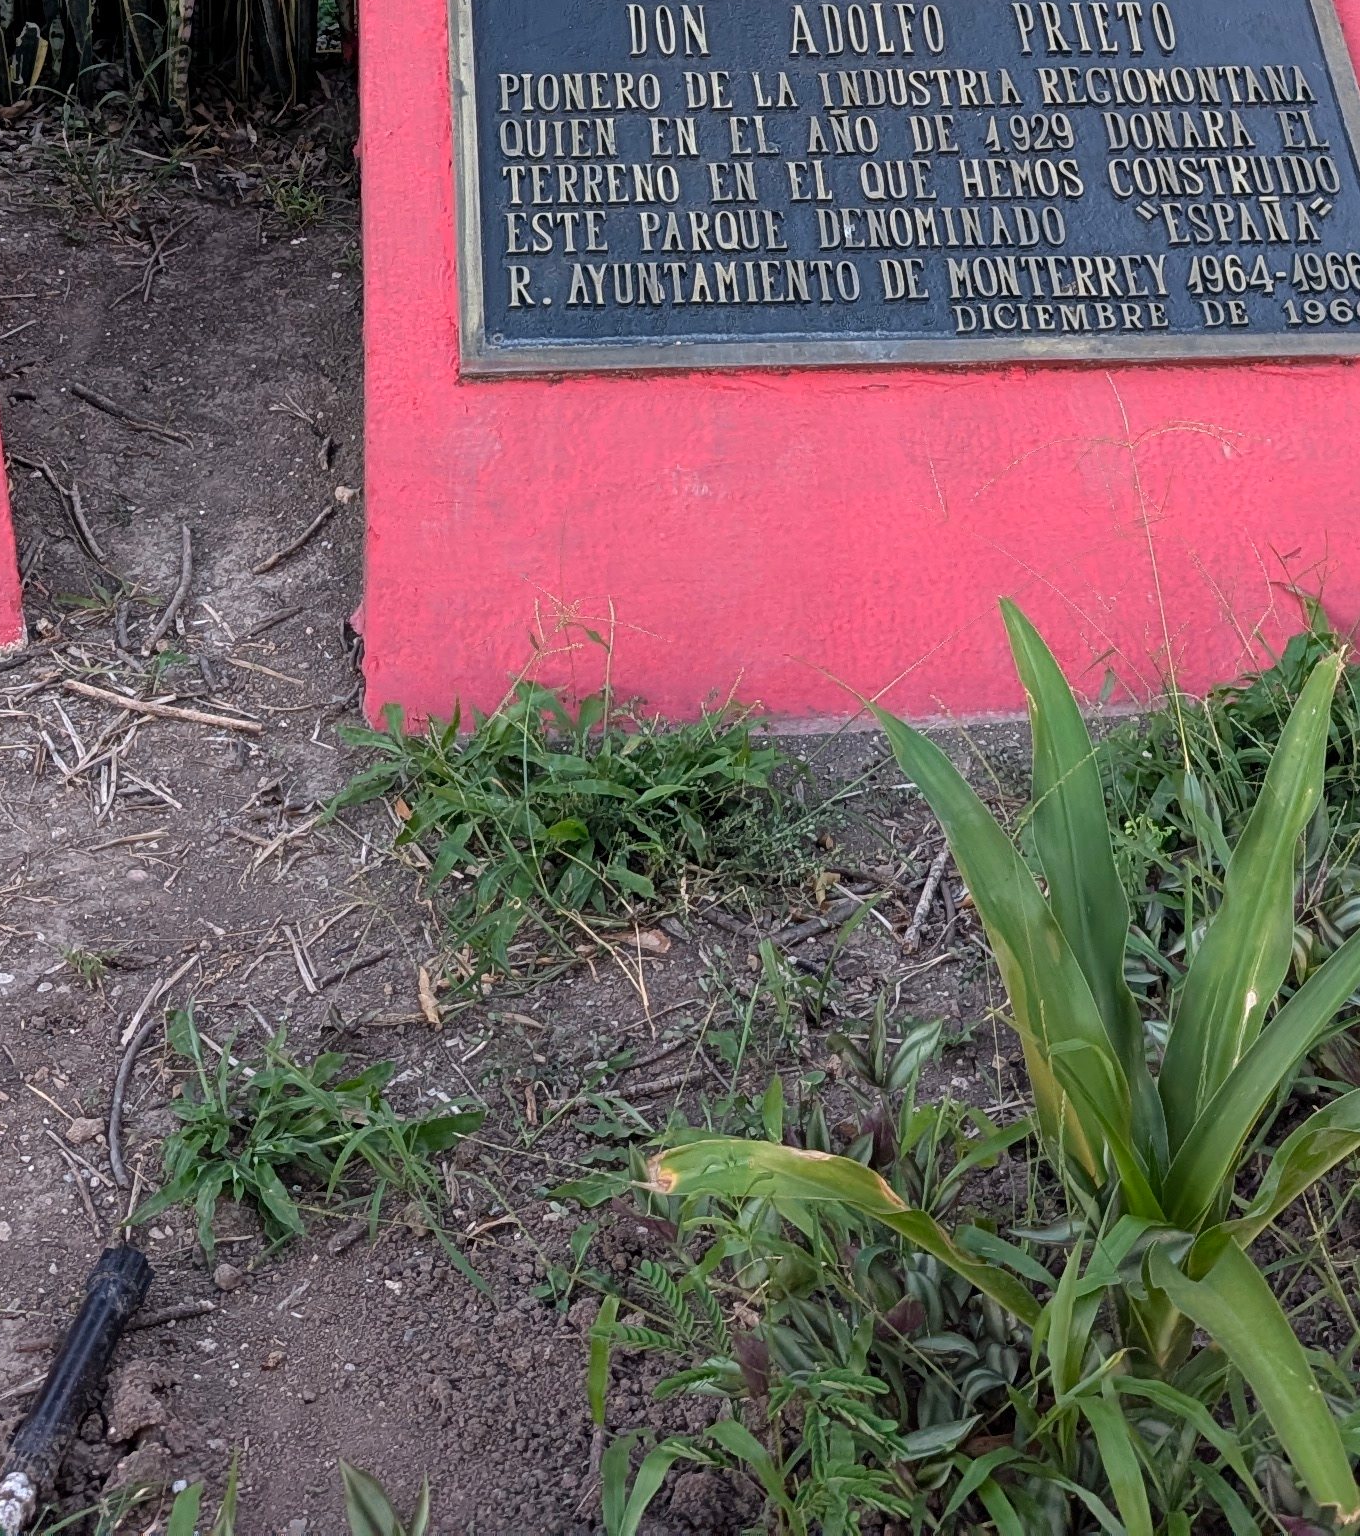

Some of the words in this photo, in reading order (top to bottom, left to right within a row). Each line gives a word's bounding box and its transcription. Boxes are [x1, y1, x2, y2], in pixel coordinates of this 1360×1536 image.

[626, 3, 711, 58] DON
[789, 0, 945, 58] ADOLFO
[1012, 1, 1176, 56] PRIETO
[498, 72, 660, 112] PIONERO
[684, 70, 733, 110] DE
[752, 70, 799, 110] LA
[819, 67, 1023, 110] INDUSTRIA
[1039, 65, 1317, 106] REGIOMONTANA
[500, 116, 619, 159] QUIEN
[649, 116, 700, 158] EN
[729, 115, 779, 155] EL
[807, 109, 880, 155] AÑO
[909, 114, 958, 154] DE
[1101, 110, 1256, 152] DONARA
[1276, 110, 1330, 151] EL
[502, 162, 680, 205] TERRENO
[707, 161, 759, 203] EN
[787, 160, 834, 202] EL
[860, 159, 937, 202] QUE
[958, 158, 1084, 199] HEMOS
[1109, 155, 1340, 198] CONSTRUIDO
[505, 209, 608, 254] ESTE
[640, 208, 788, 253] PARQUE
[815, 205, 1066, 251] DENOMINADO
[508, 264, 553, 307] R.
[566, 260, 860, 306] AYUNTAMIENTO
[879, 258, 930, 302] DE
[948, 253, 1168, 299] MONTERREY
[952, 302, 1169, 333] DICIEMBRE
[1199, 300, 1248, 327] DE
